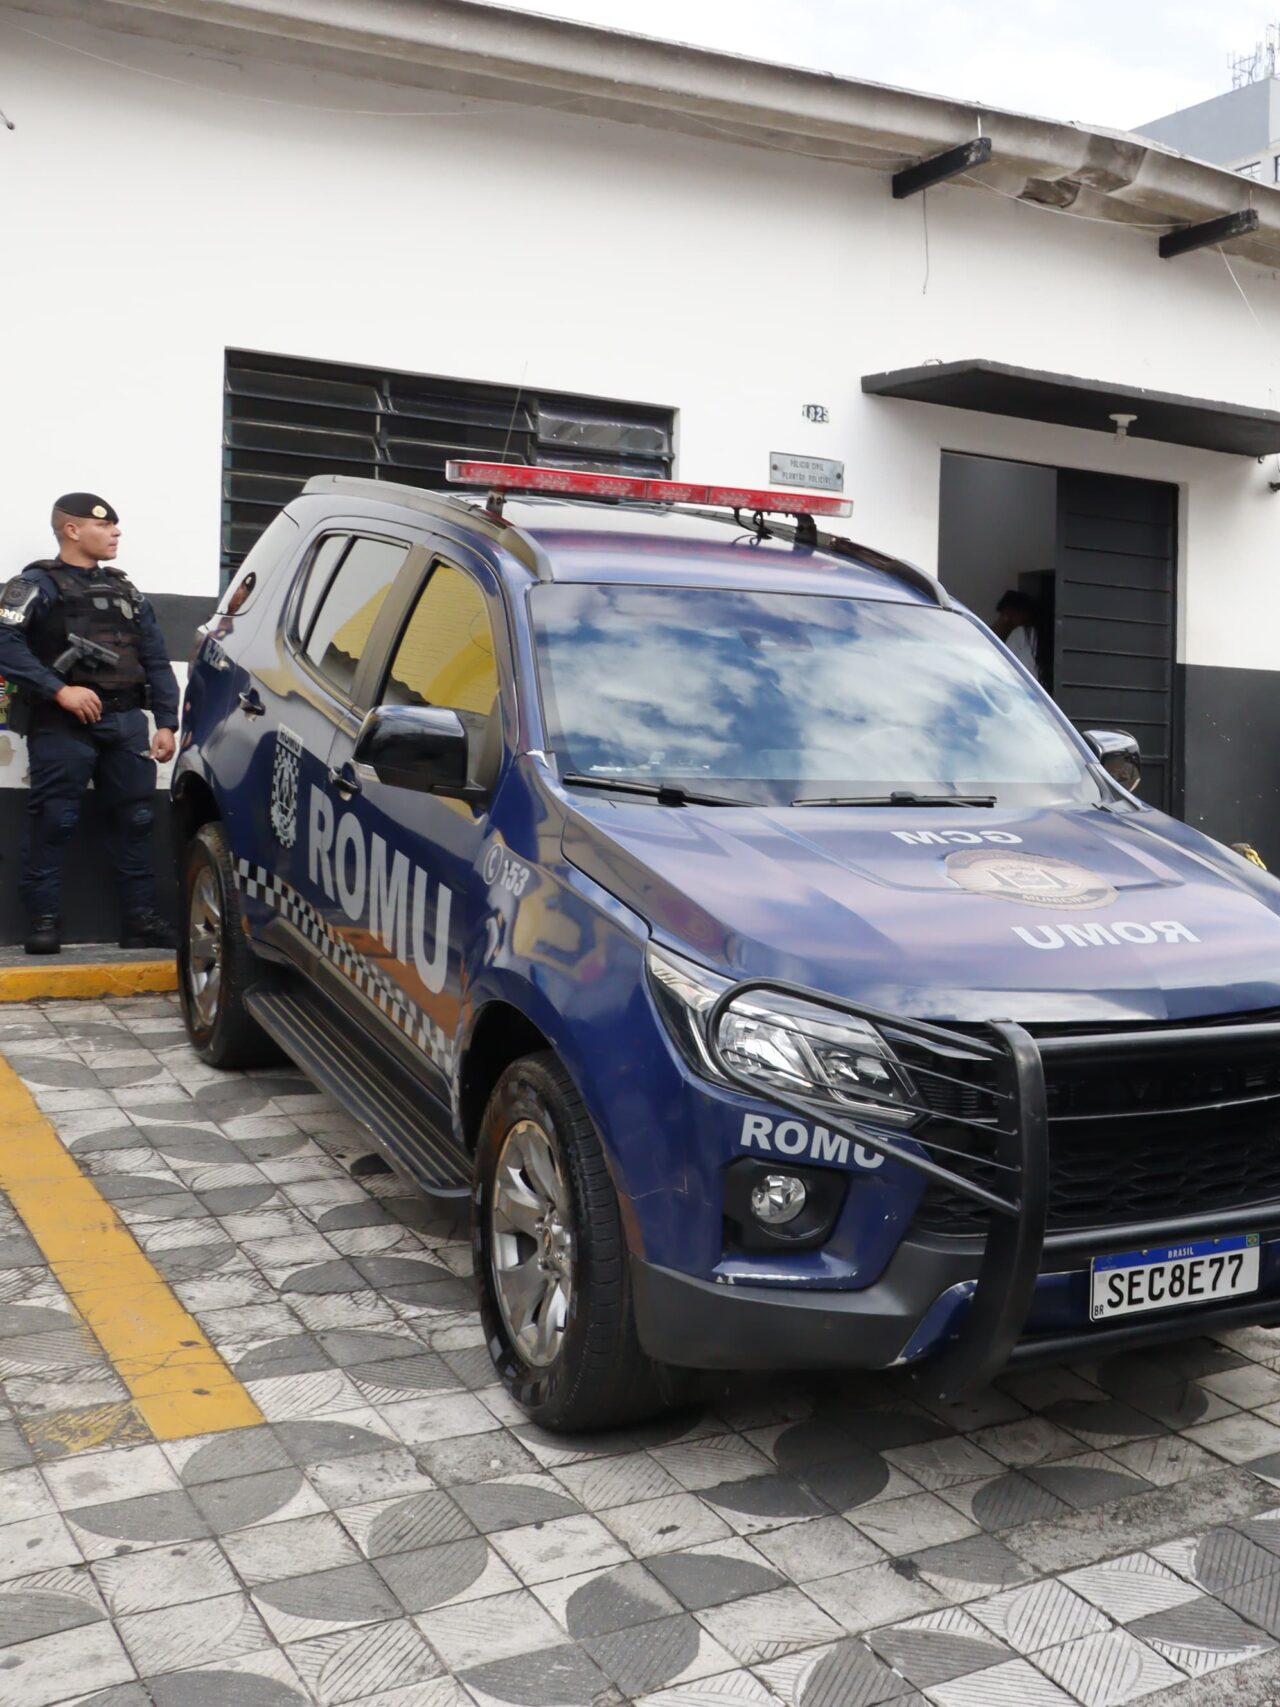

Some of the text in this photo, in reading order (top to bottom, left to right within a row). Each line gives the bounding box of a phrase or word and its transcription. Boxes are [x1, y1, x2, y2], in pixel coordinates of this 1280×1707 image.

[308, 783, 452, 994] ROMU
[503, 859, 530, 897] 153
[740, 1113, 888, 1169] ROMU
[1167, 1247, 1194, 1259] BRASIL
[1107, 1253, 1244, 1309] SEC8E77
[1094, 1305, 1104, 1316] BR
